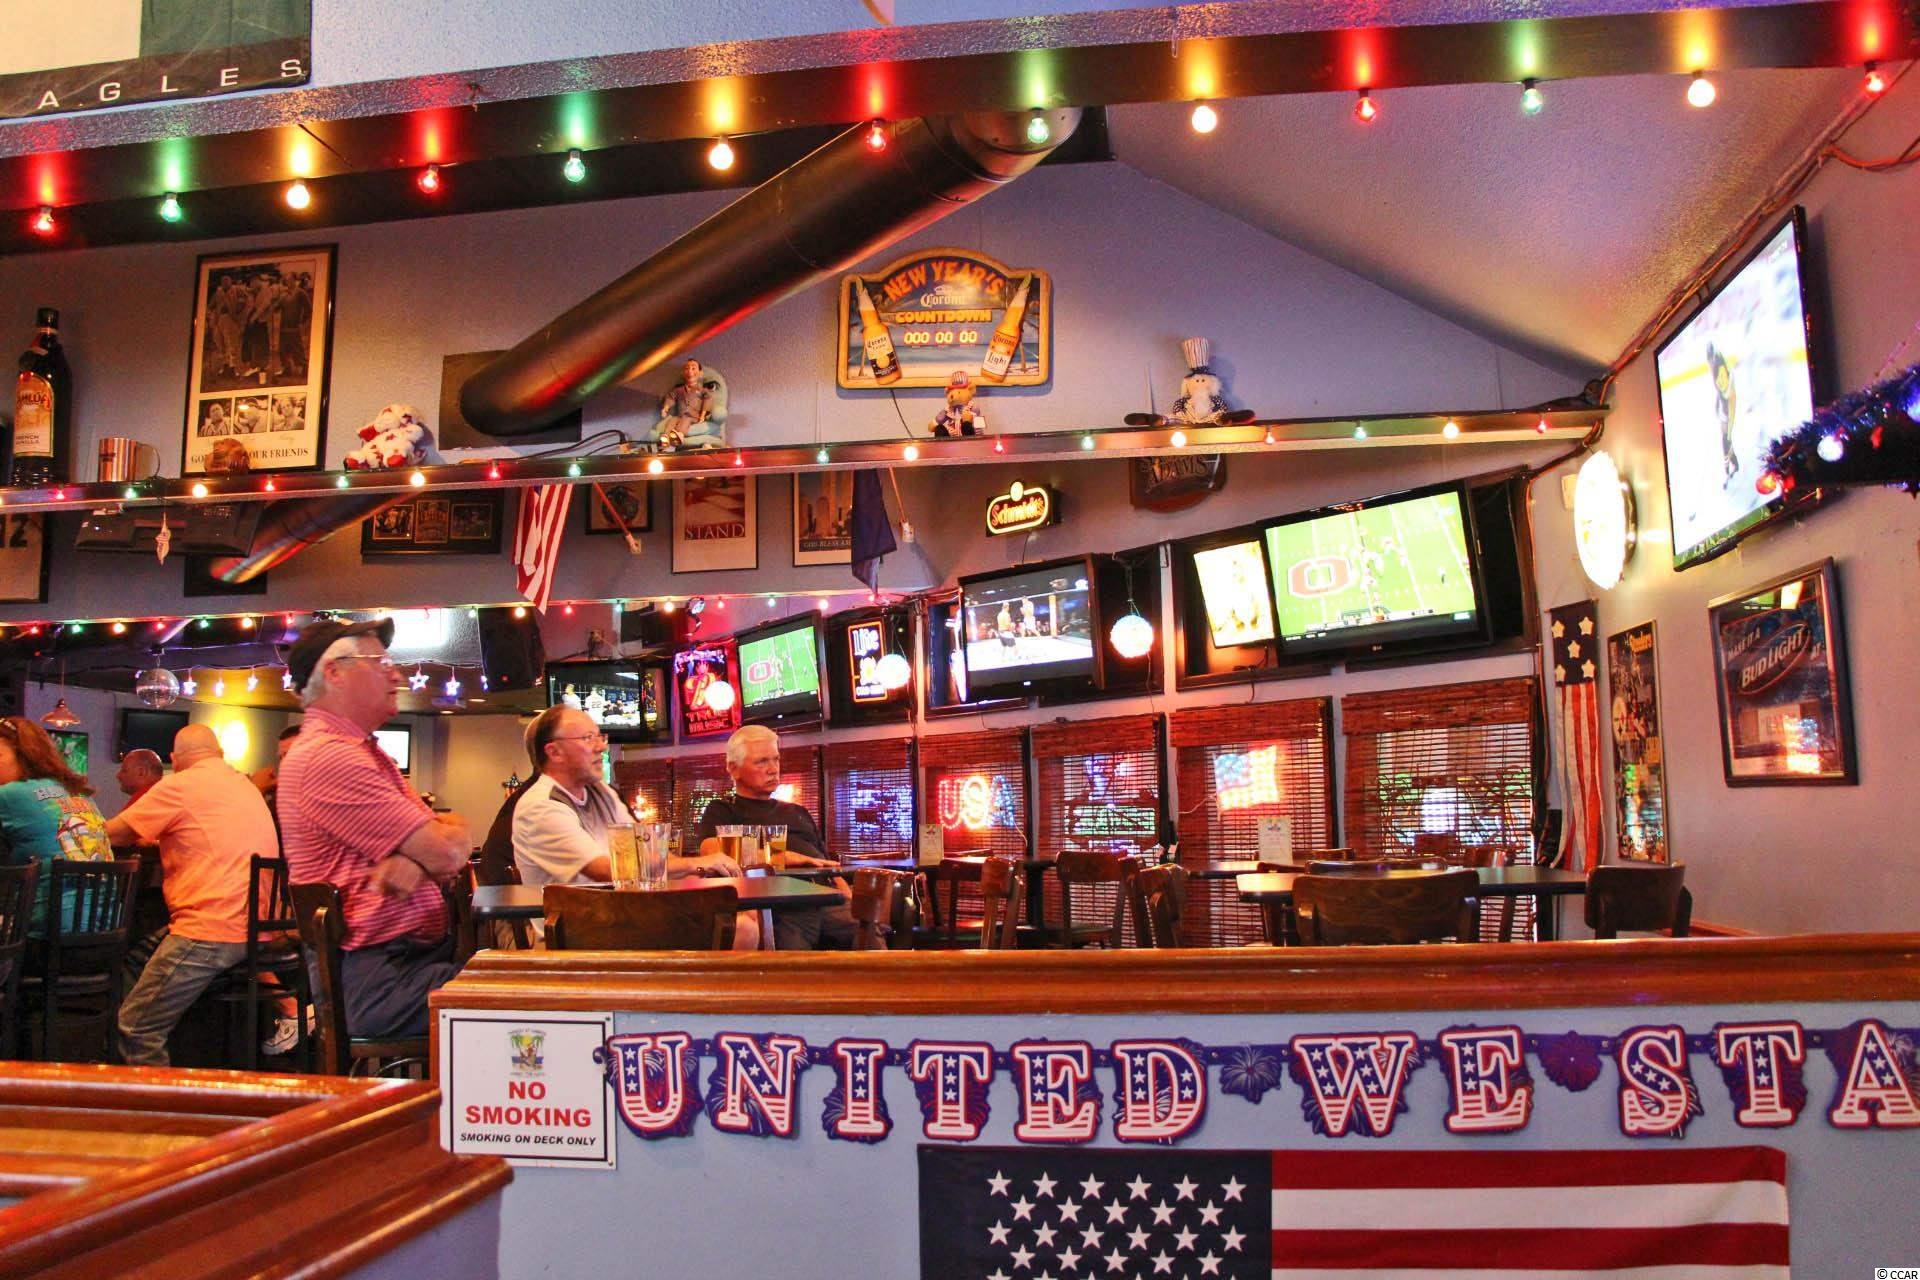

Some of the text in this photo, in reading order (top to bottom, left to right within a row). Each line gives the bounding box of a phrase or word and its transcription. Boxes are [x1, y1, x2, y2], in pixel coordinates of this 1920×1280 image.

[884, 261, 1005, 302] NEW YEAR'S
[921, 293, 968, 308] Corona
[895, 309, 992, 324] COUNTDOWN
[904, 331, 930, 344] 000
[935, 331, 953, 343] 00
[987, 352, 1007, 365] Light
[249, 451, 267, 460] OUR
[270, 447, 309, 457] FRIENDS
[686, 523, 745, 540] STAND
[1742, 627, 1803, 689] BUD LIGHT
[686, 709, 729, 722] TRUE
[938, 774, 1015, 829] USA
[606, 1019, 1920, 1143] UNITED WE STA
[508, 1081, 546, 1100] NO
[465, 1105, 592, 1128] SMOKING
[460, 1132, 596, 1146] SMOKING ON DECK ONLY
